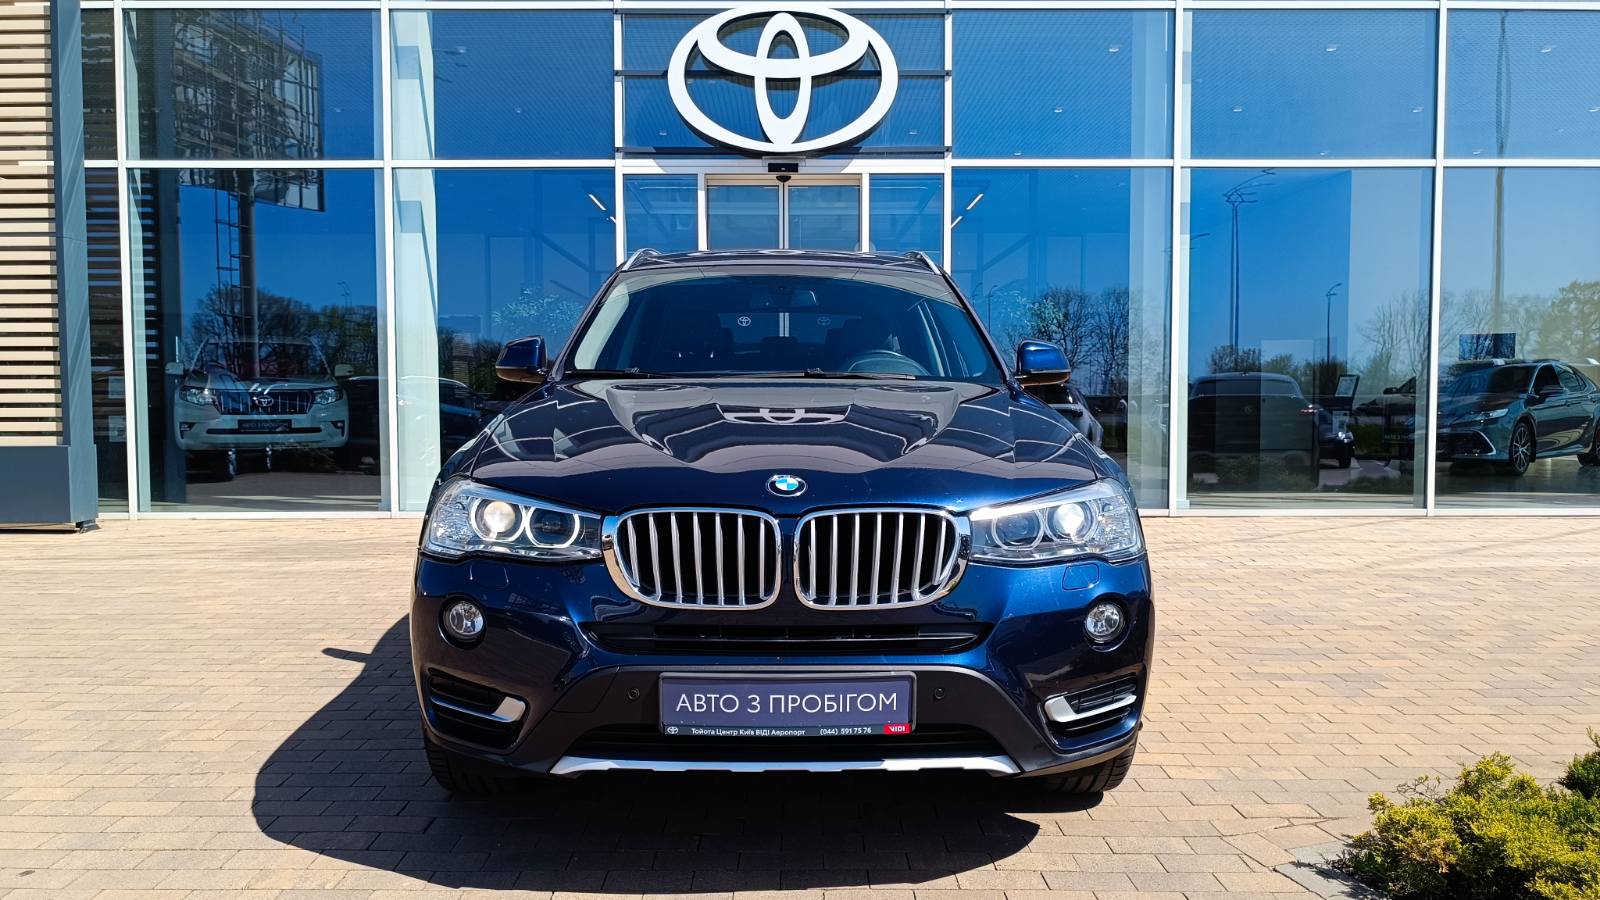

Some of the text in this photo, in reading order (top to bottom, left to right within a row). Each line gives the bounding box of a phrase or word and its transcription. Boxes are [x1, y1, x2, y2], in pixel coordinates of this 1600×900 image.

[676, 693, 739, 712] АВТО
[769, 692, 897, 713] ПРОБІГОМ
[691, 727, 805, 737] Тойота Центр Київ ВІДІ Аеропорт
[841, 727, 853, 735] 591
[888, 725, 906, 733] VIDI
